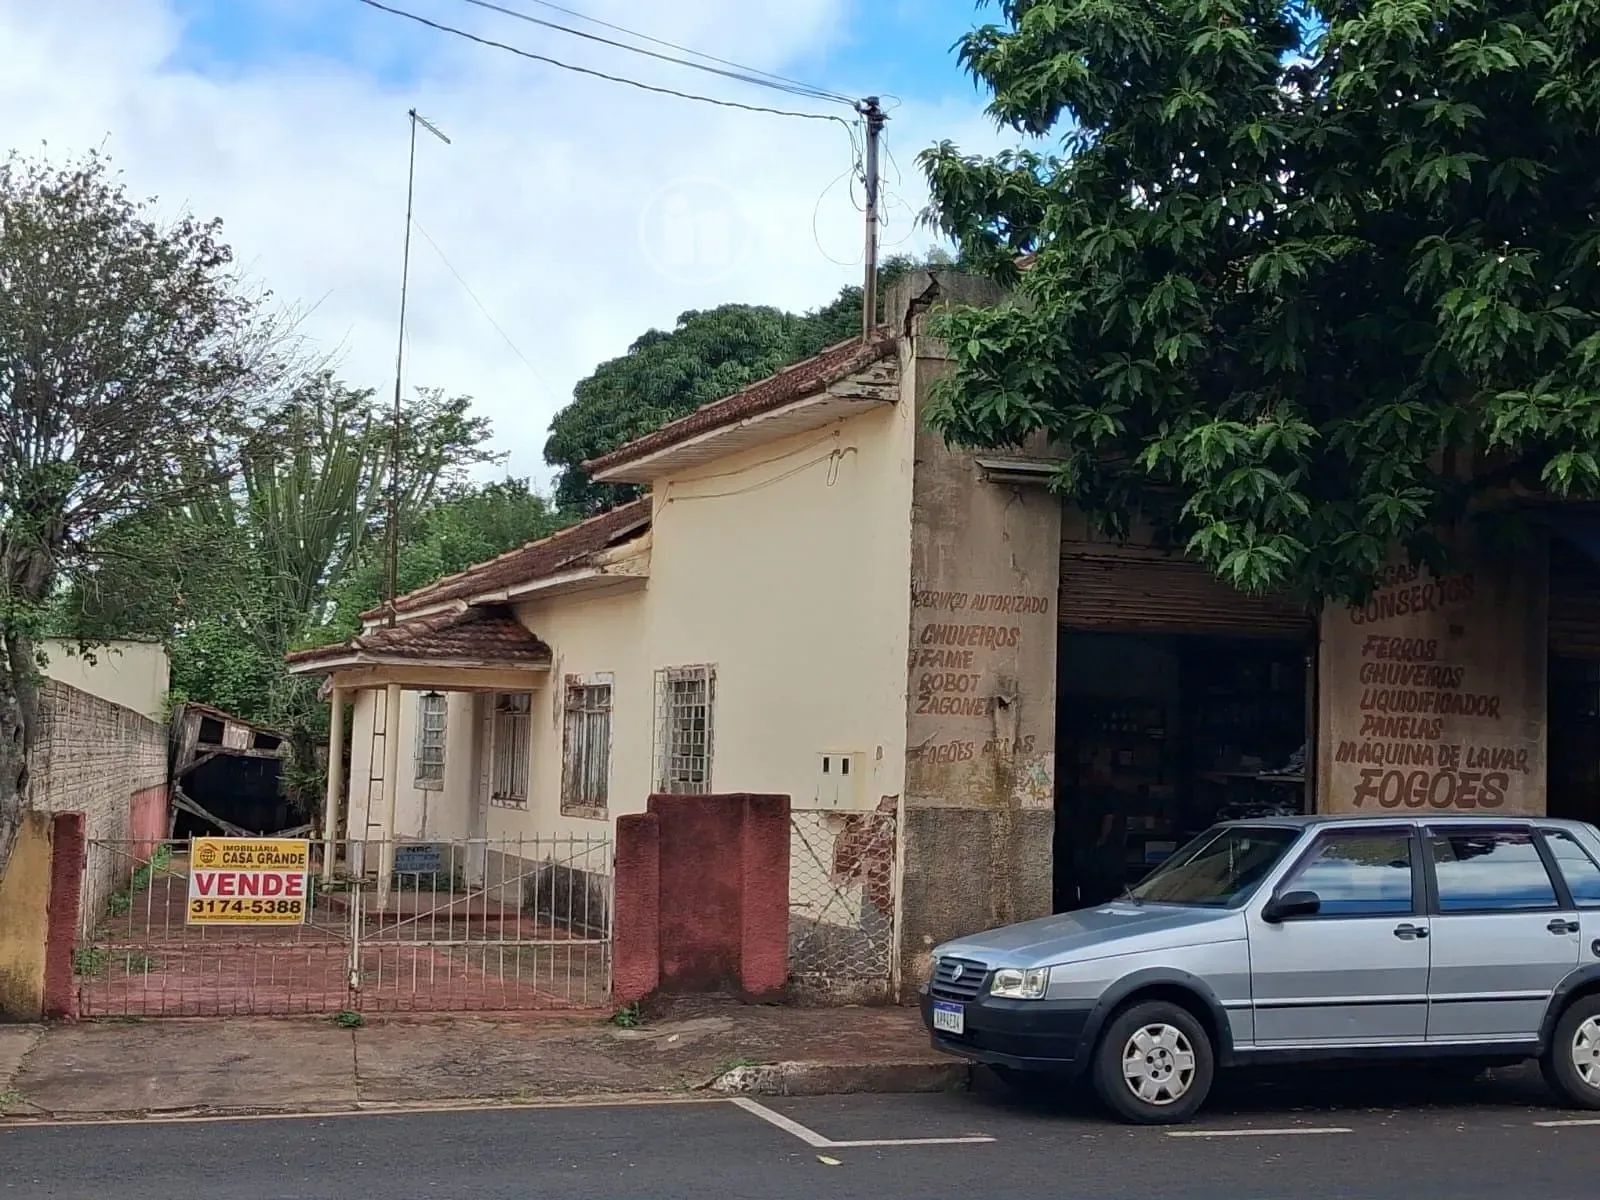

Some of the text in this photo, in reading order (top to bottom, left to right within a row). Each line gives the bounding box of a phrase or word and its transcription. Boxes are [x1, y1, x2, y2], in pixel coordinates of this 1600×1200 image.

[971, 593, 1049, 614] AUTORIZADO
[920, 623, 1021, 650] CHUVEIROS
[1362, 634, 1437, 662] FERROS
[919, 650, 974, 669] FAME
[919, 672, 981, 694] ROBOT
[1359, 663, 1464, 689] CHUVEIROS
[1359, 689, 1501, 720] LIQUIDIFICADOR
[1359, 714, 1444, 740] PANELAS
[1335, 738, 1531, 775] MÁQUINA DE LAVAR
[1351, 766, 1510, 809] FOGÕES
[222, 852, 305, 864] CASA GRANDE
[195, 873, 303, 896] VENDE
[191, 899, 301, 914] 3174-5388
